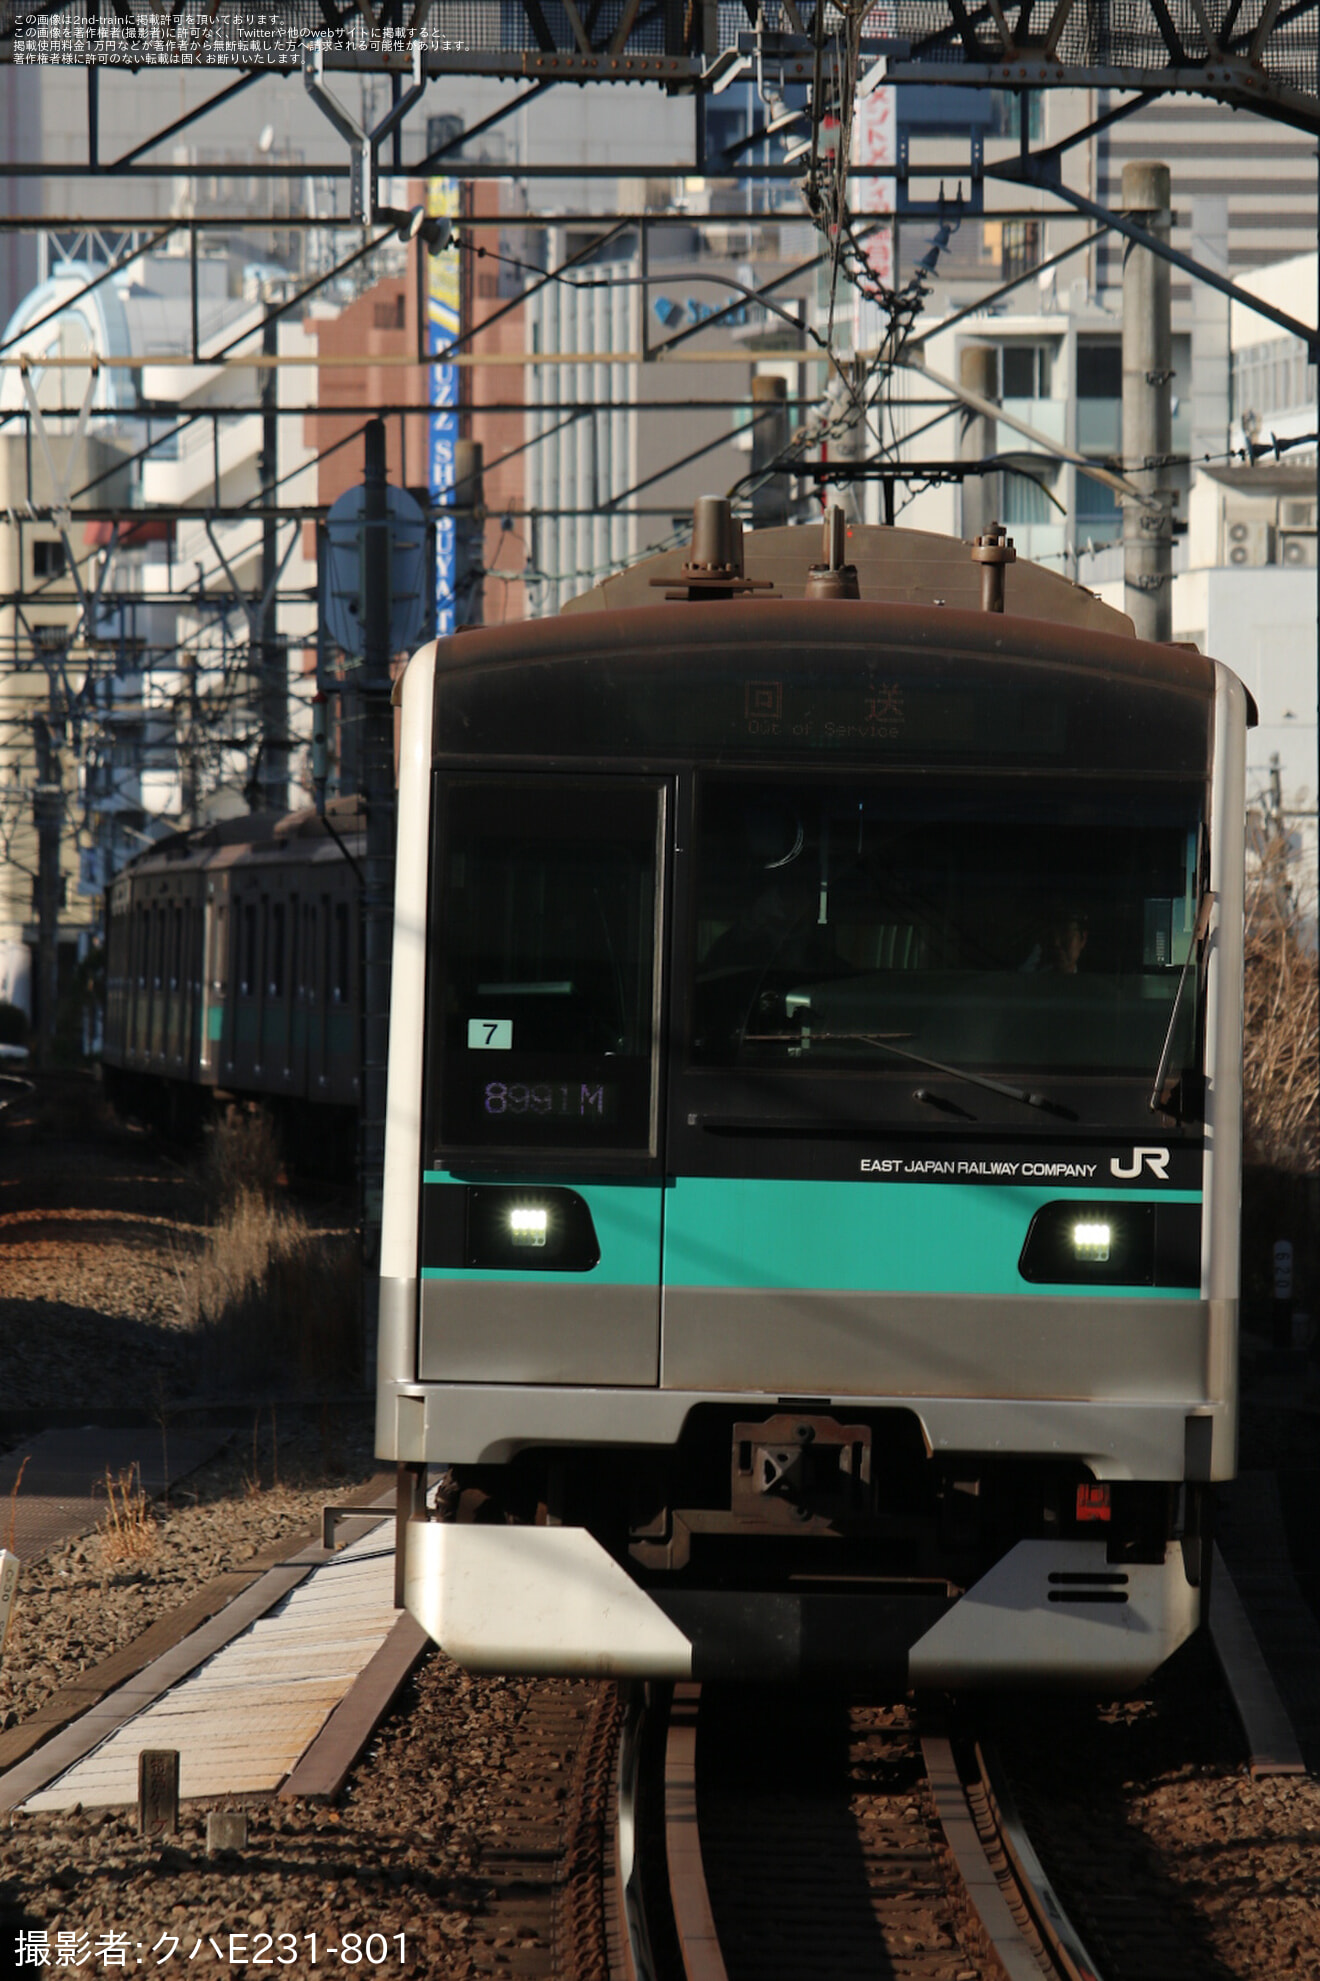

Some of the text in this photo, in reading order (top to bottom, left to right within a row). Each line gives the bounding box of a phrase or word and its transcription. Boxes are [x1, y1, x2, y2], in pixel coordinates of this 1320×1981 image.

[748, 720, 900, 739] Out of Service
[482, 1023, 498, 1045] 7
[861, 1159, 1097, 1178] EAST JAPAN RAILWAY COMPANY
[1110, 1146, 1170, 1180] JR
